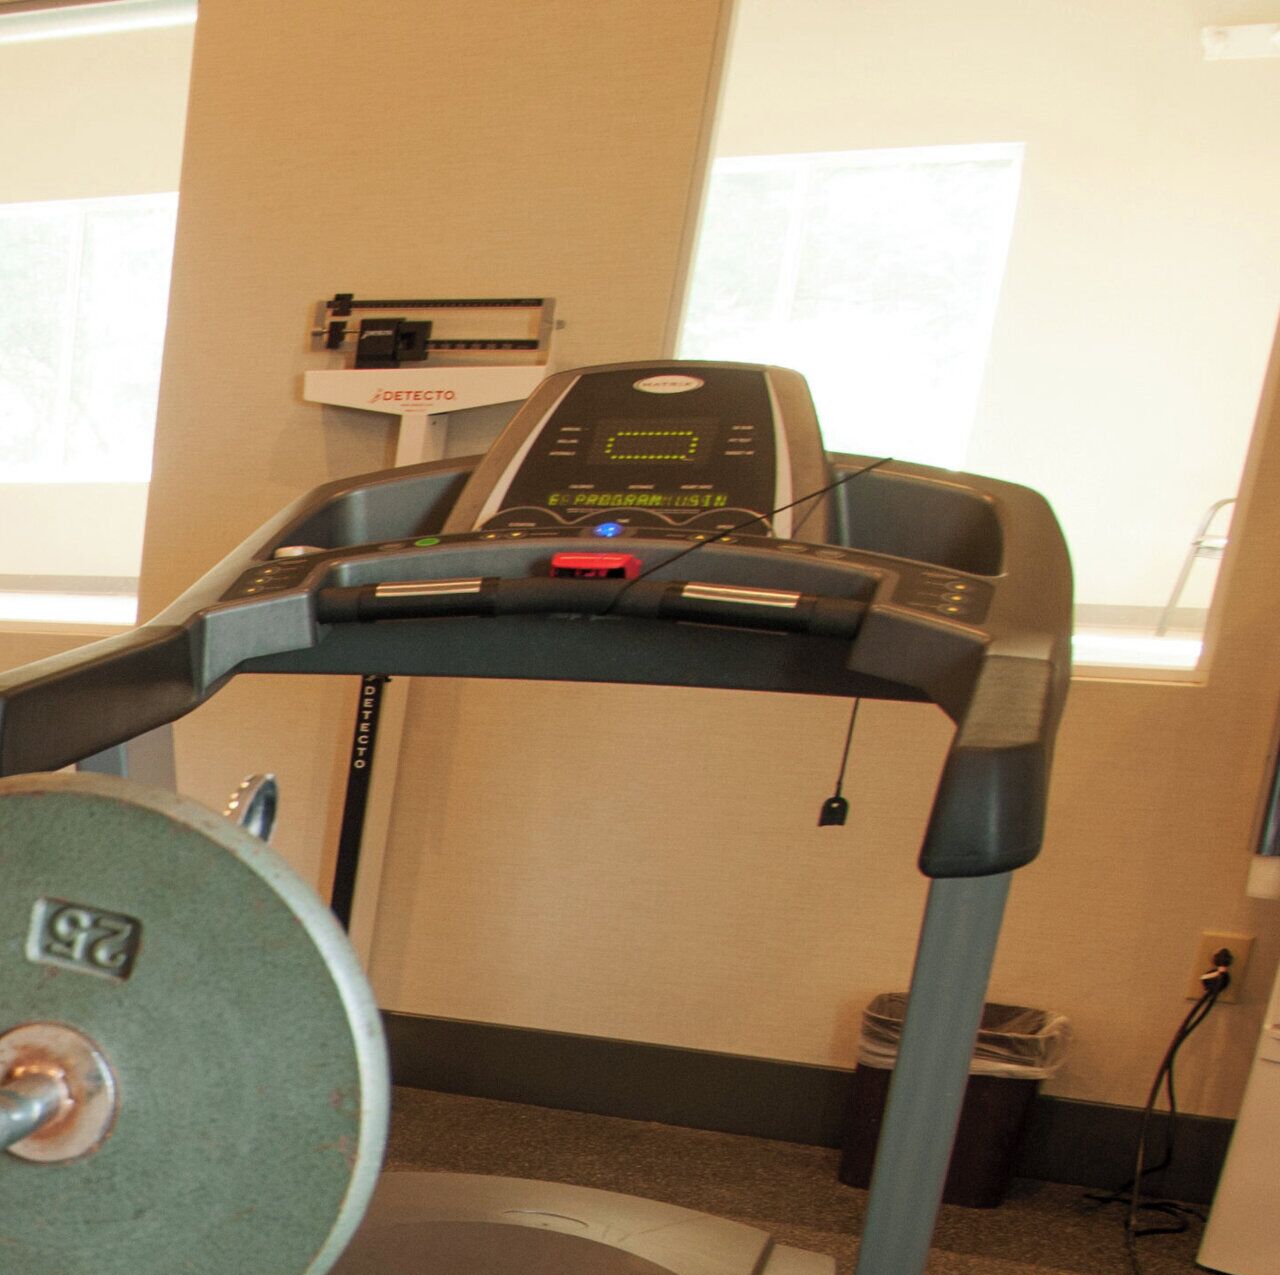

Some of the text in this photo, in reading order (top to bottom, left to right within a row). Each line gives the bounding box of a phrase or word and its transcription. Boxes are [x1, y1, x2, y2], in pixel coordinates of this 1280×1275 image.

[382, 390, 456, 401] DETECTO
[354, 686, 376, 769] DETECTO
[46, 907, 133, 968] 25
